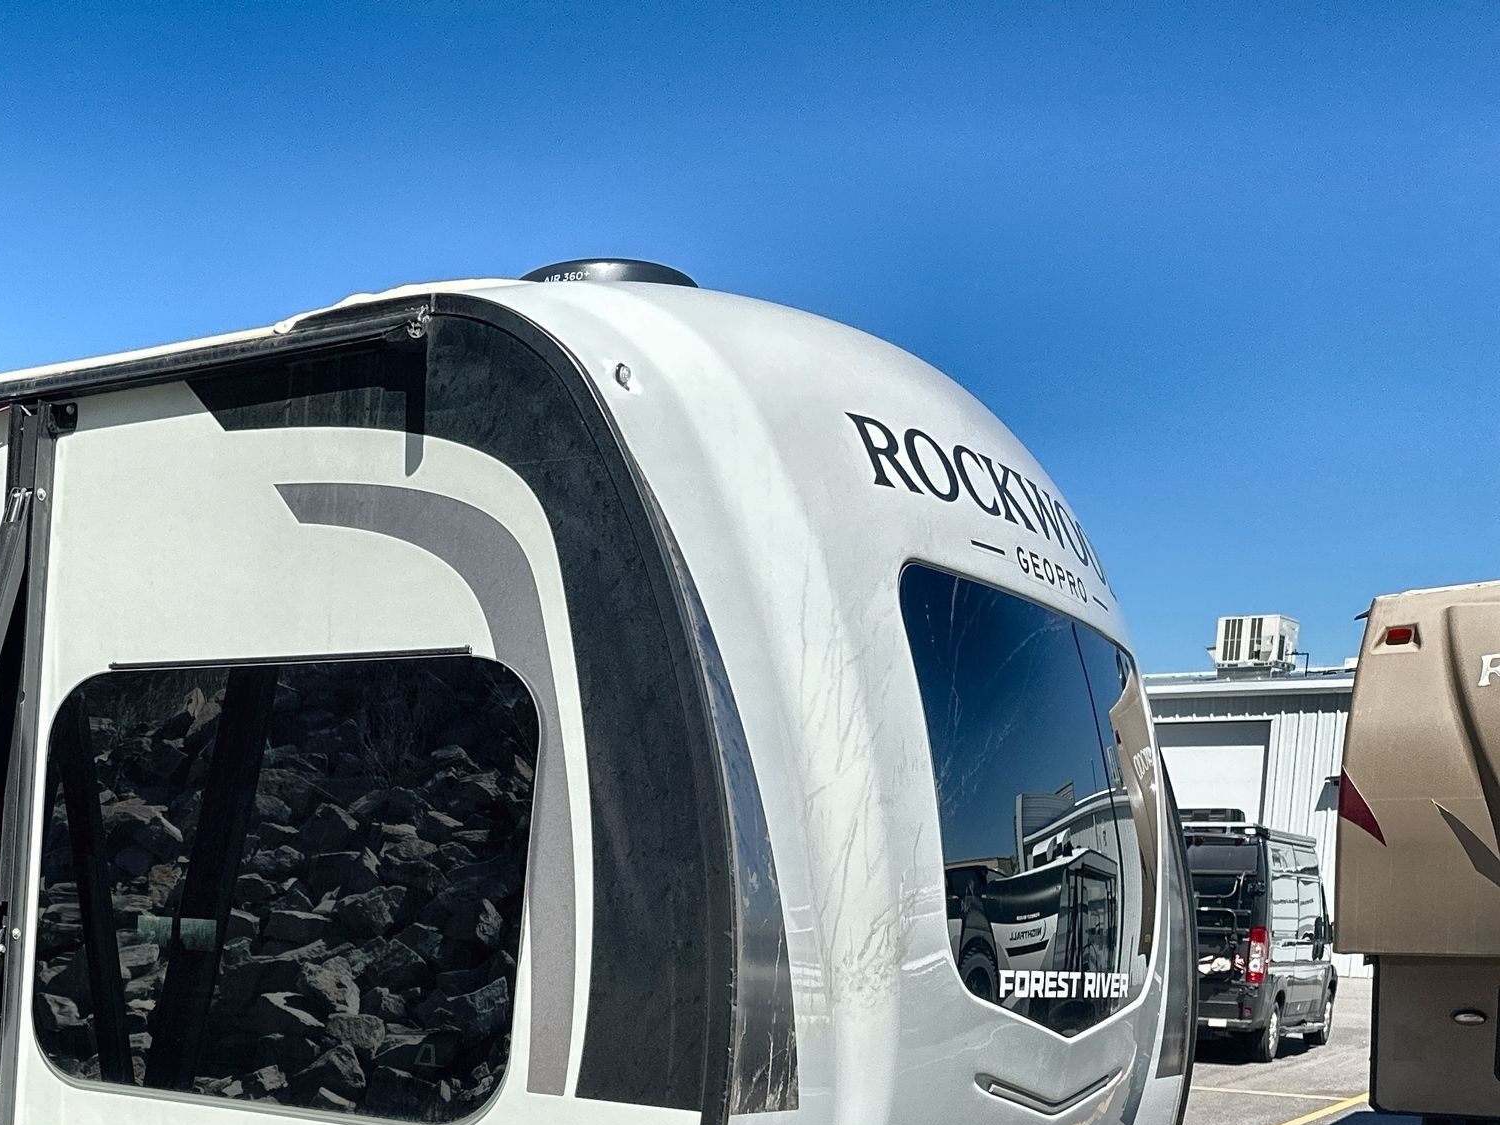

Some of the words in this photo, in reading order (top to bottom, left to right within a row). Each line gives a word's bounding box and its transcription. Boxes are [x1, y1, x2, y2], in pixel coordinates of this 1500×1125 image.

[844, 411, 1117, 601] ROCKWOO
[1016, 546, 1087, 603] GEOPRO
[999, 970, 1081, 998] FOREST
[1084, 971, 1129, 998] RIVER
